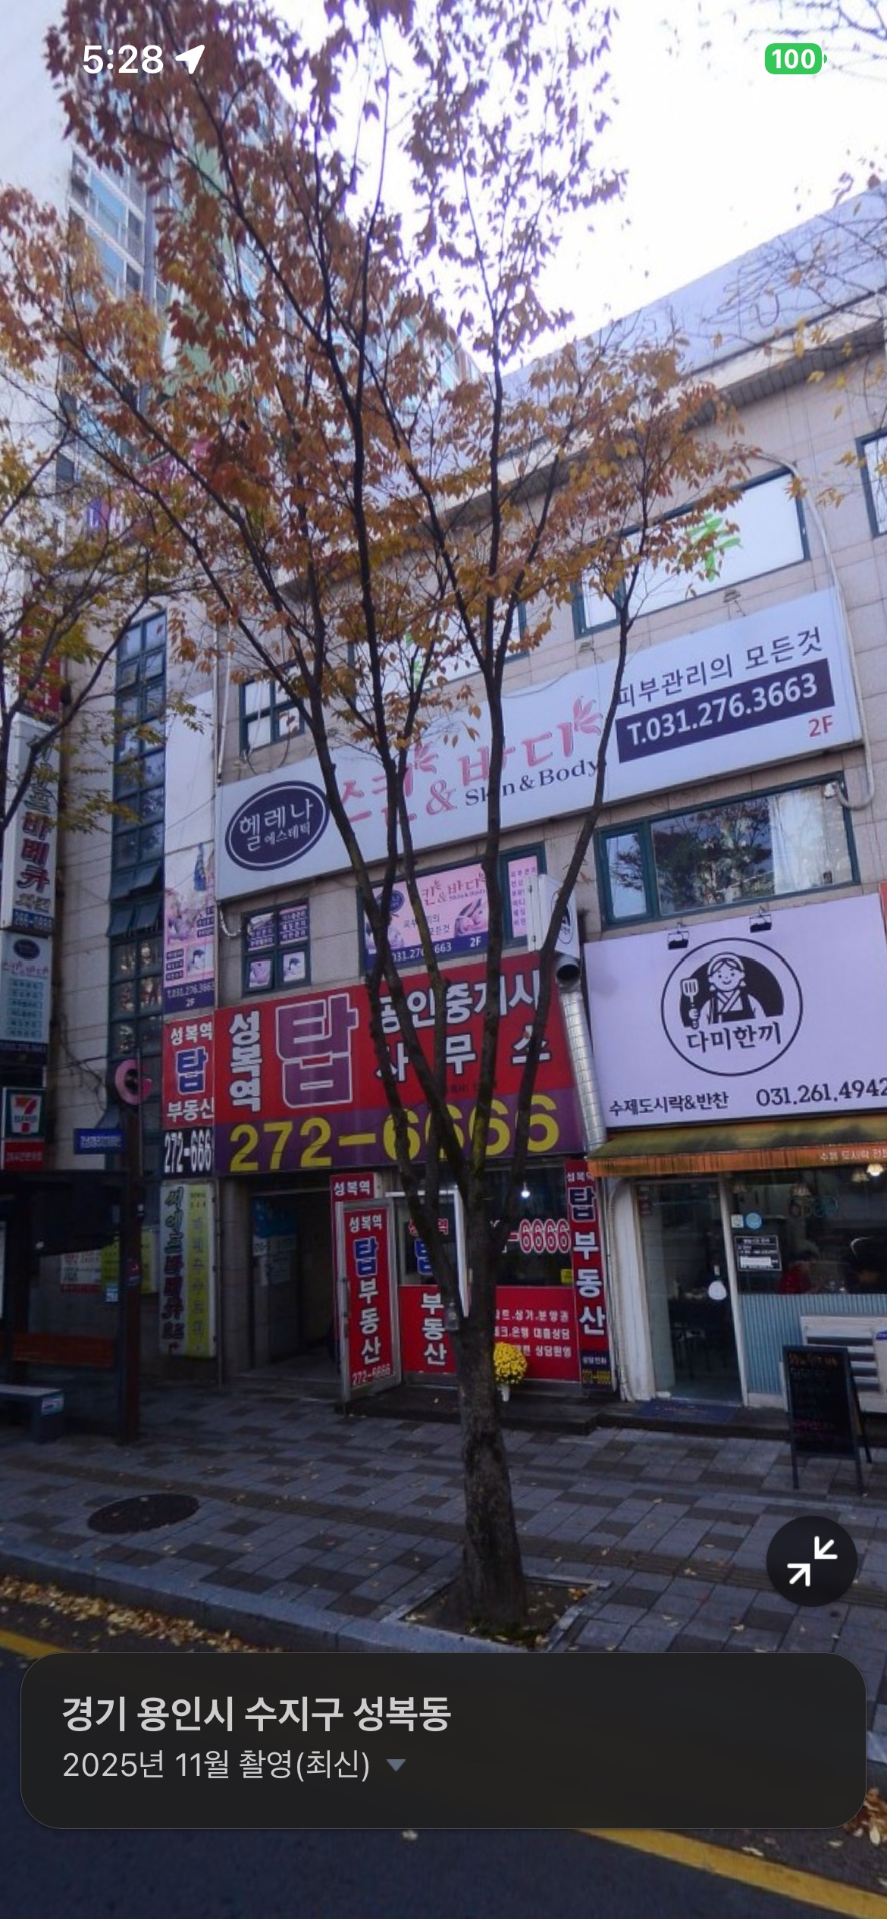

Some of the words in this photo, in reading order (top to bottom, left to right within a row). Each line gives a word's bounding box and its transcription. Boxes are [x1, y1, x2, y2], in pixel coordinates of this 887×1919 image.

[618, 654, 732, 708] 피부관리의
[745, 626, 823, 671] 모든것
[626, 673, 818, 746] T.031.276.3663
[808, 715, 833, 738] 2F
[464, 784, 516, 807] Skn
[239, 798, 314, 852] 헬레나
[470, 937, 482, 948] 2F
[170, 1021, 214, 1046] 성복역
[275, 993, 359, 1109] 탑
[686, 1021, 783, 1053] 다미한끼
[175, 1046, 209, 1095] 탑
[229, 1010, 262, 1113] 성복역
[609, 1091, 730, 1117] 수제도시락&반찬
[756, 1077, 887, 1107] 031.261.4942
[333, 1181, 371, 1197] 성복역
[568, 1186, 597, 1223] 탑
[349, 1214, 382, 1233] 성복역
[353, 1236, 378, 1276] 탑
[572, 1231, 606, 1337] 부동산
[358, 1278, 381, 1365] 부동산
[420, 1292, 447, 1366] 부동산
